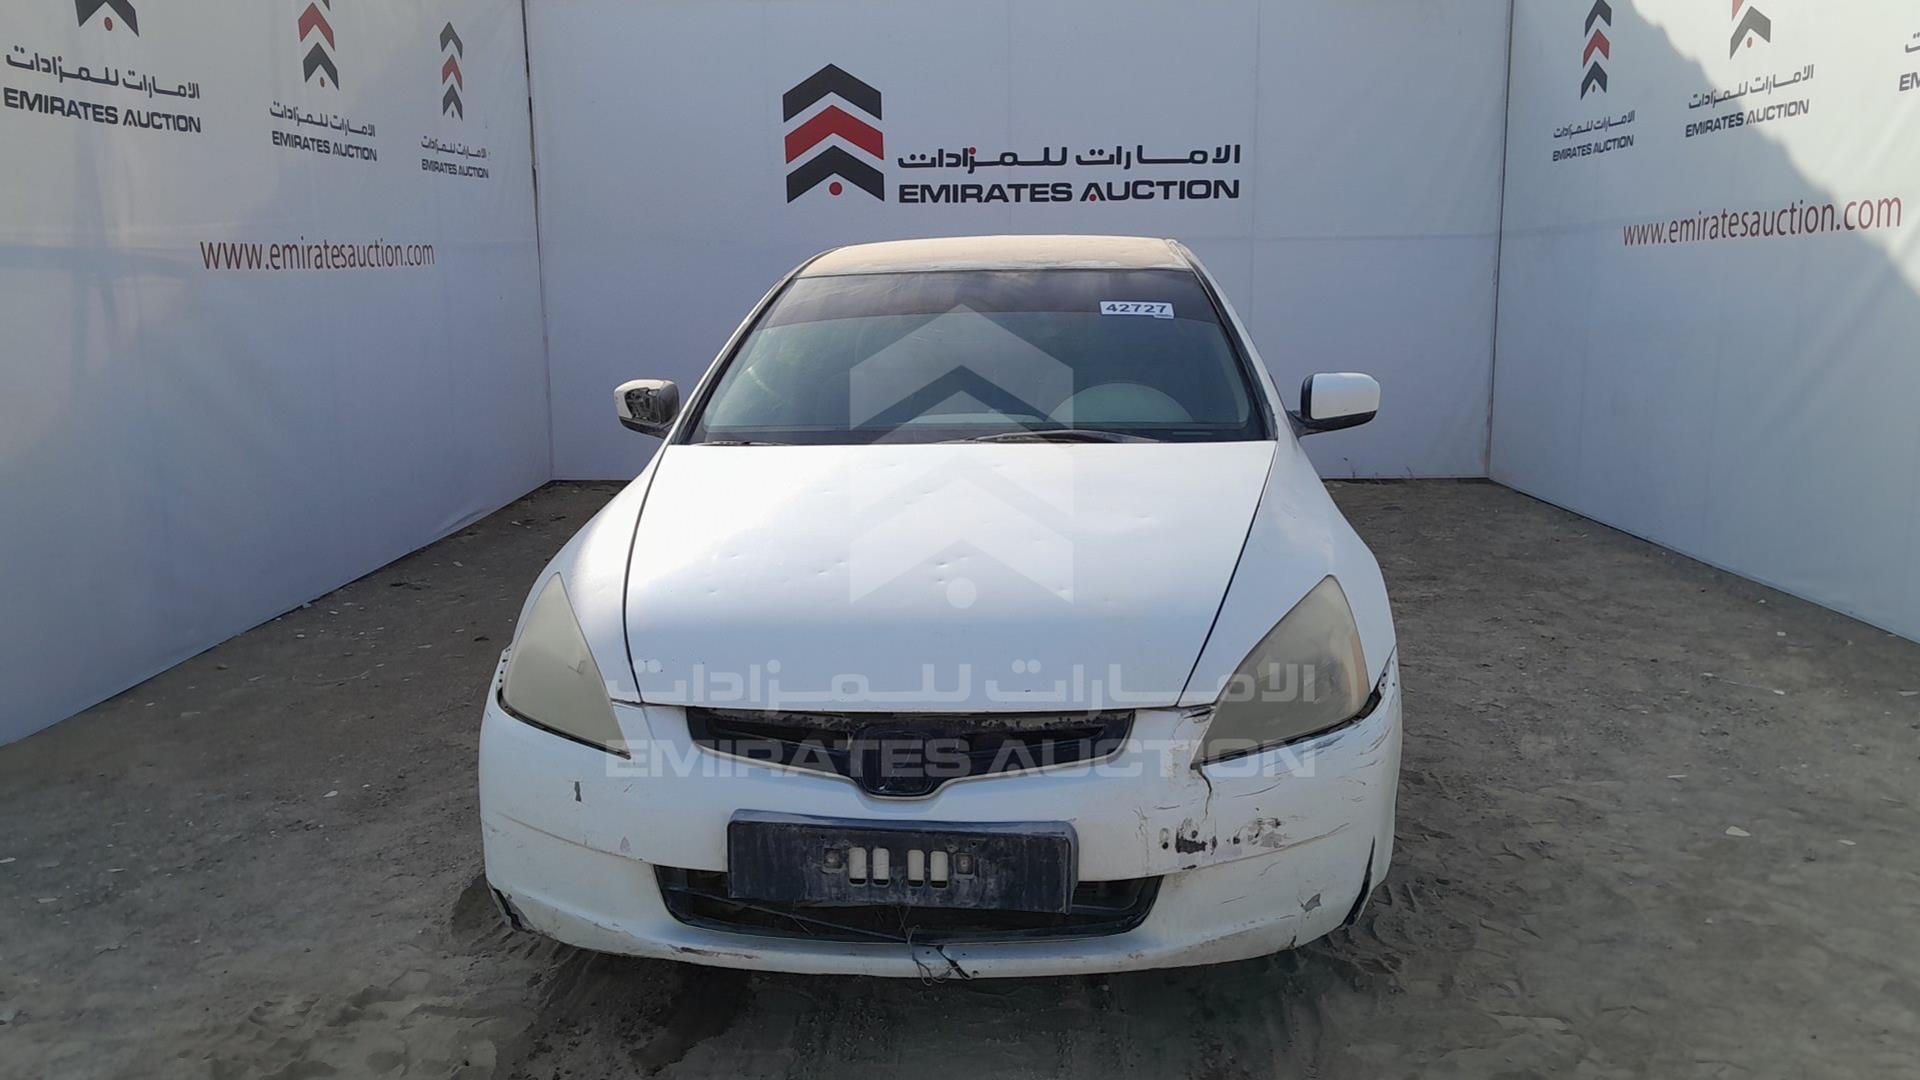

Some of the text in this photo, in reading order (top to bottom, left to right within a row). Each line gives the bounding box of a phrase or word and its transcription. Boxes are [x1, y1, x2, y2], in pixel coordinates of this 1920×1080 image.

[4, 87, 201, 133] EMIRATES AUCTION
[1685, 100, 1809, 138] EMIRATES AUCTION
[272, 131, 377, 161] EMIRATES AUCTION
[1553, 135, 1633, 162] EMIRATES AUCTION
[422, 159, 488, 178] EMIRATES AUCTION
[899, 180, 1239, 203] EMIRATES AUCTION
[1624, 196, 1901, 246] www.emiratesauction.com
[200, 236, 435, 271] www.emiratesauction.com
[1106, 303, 1167, 314] 42727
